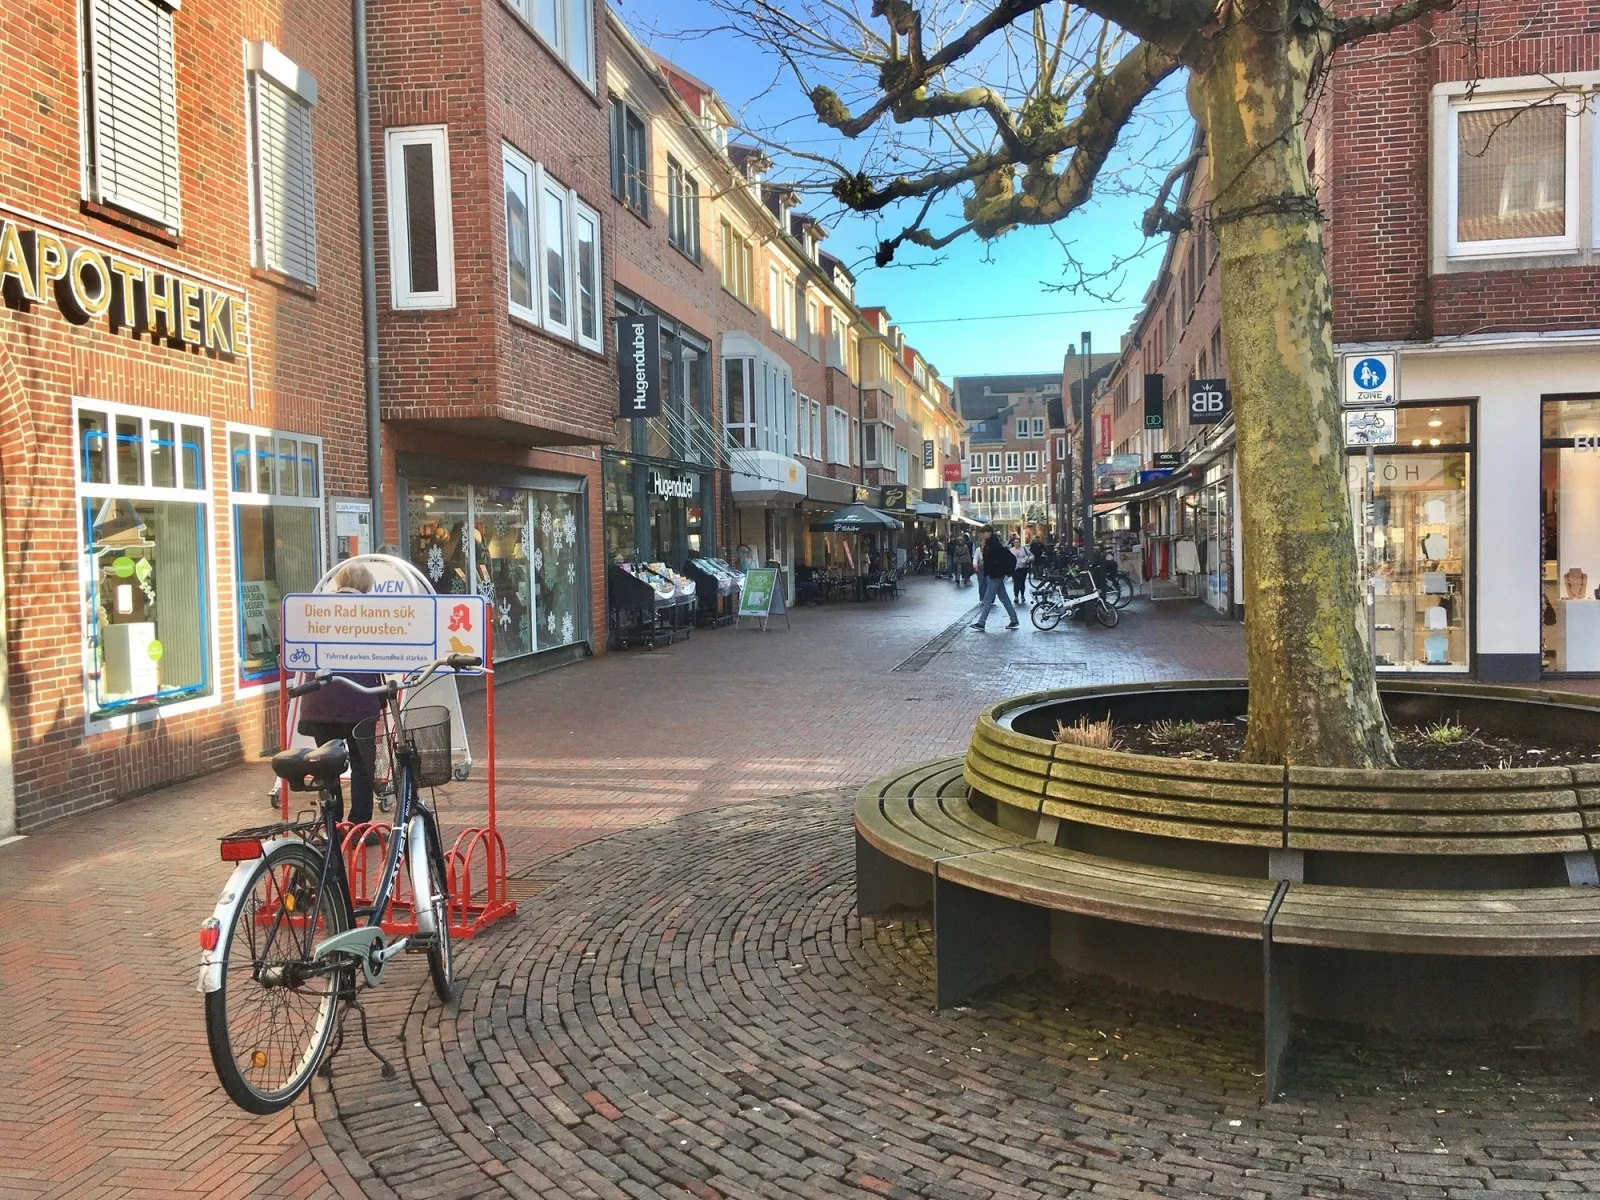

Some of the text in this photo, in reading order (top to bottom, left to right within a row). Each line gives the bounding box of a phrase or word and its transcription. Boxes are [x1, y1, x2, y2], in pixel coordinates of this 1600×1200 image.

[0, 219, 248, 357] APOTHEKE
[631, 323, 649, 410] Hugendubel
[1357, 391, 1383, 400] ZONE
[925, 442, 933, 467] KIND
[653, 471, 693, 501] Hugendubel
[976, 474, 1014, 485] gröttrup
[304, 604, 416, 619] Dien Rad kann sük
[308, 621, 331, 634] hier
[372, 653, 405, 661] Gesundheit
